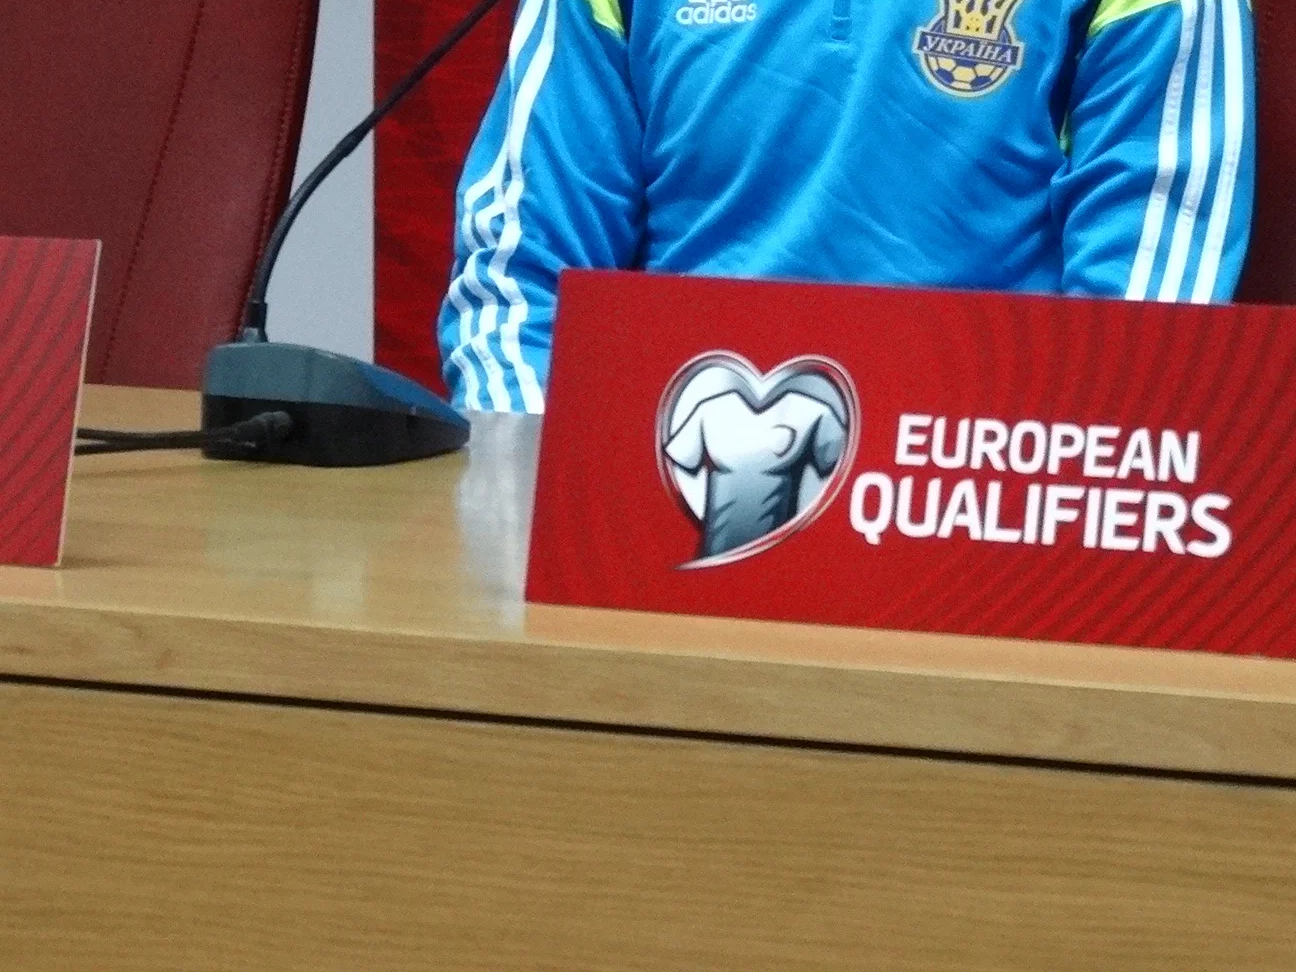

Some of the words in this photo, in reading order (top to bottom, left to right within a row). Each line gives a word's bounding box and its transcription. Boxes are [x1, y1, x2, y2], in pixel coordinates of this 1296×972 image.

[675, 0, 757, 26] adidas
[923, 34, 1013, 65] УКРАЇНА
[895, 414, 1200, 484] EUROPEAN
[849, 470, 1233, 558] QUALIFIERS
